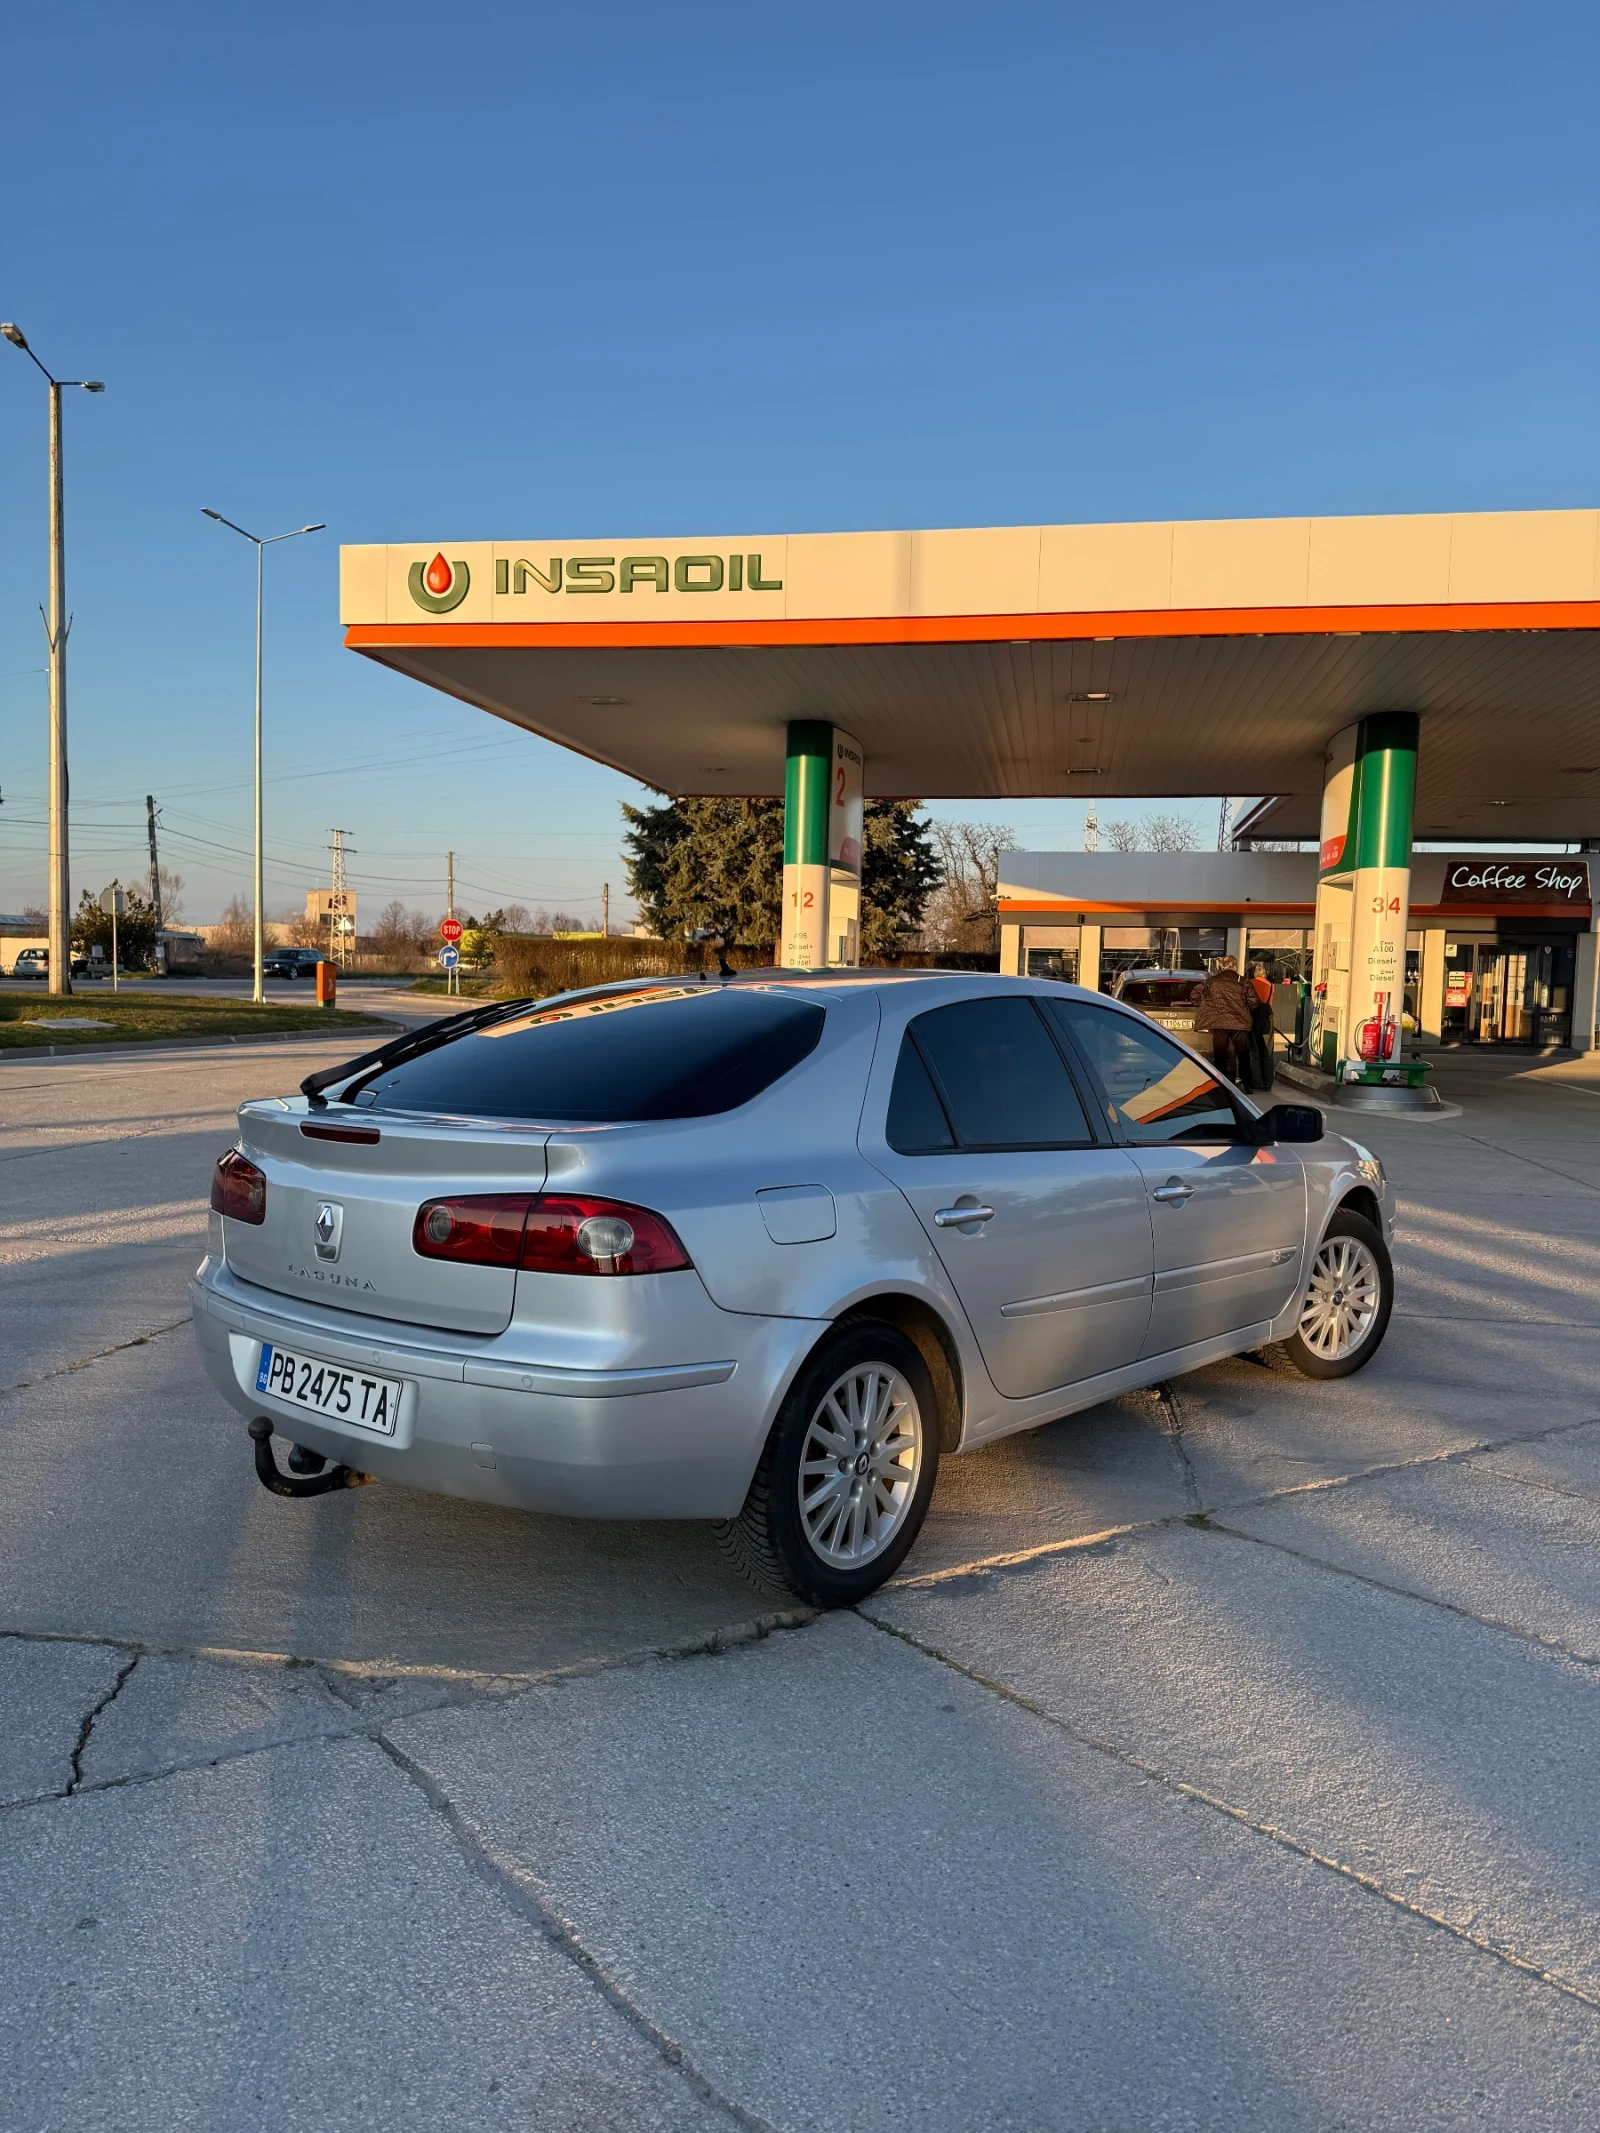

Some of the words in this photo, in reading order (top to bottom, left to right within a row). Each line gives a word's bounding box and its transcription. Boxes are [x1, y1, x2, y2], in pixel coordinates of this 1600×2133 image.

[495, 554, 783, 594] INSAOIL
[835, 766, 846, 808] 2
[1451, 865, 1527, 889] Coffee
[1534, 866, 1583, 899] Shop
[443, 924, 461, 936] STOP
[1372, 945, 1394, 953] A100
[1369, 974, 1395, 982] Diesel
[288, 1263, 377, 1292] LAGUNA
[259, 1372, 268, 1384] BG
[296, 1362, 354, 1413] 2475
[360, 1378, 388, 1427] TA
